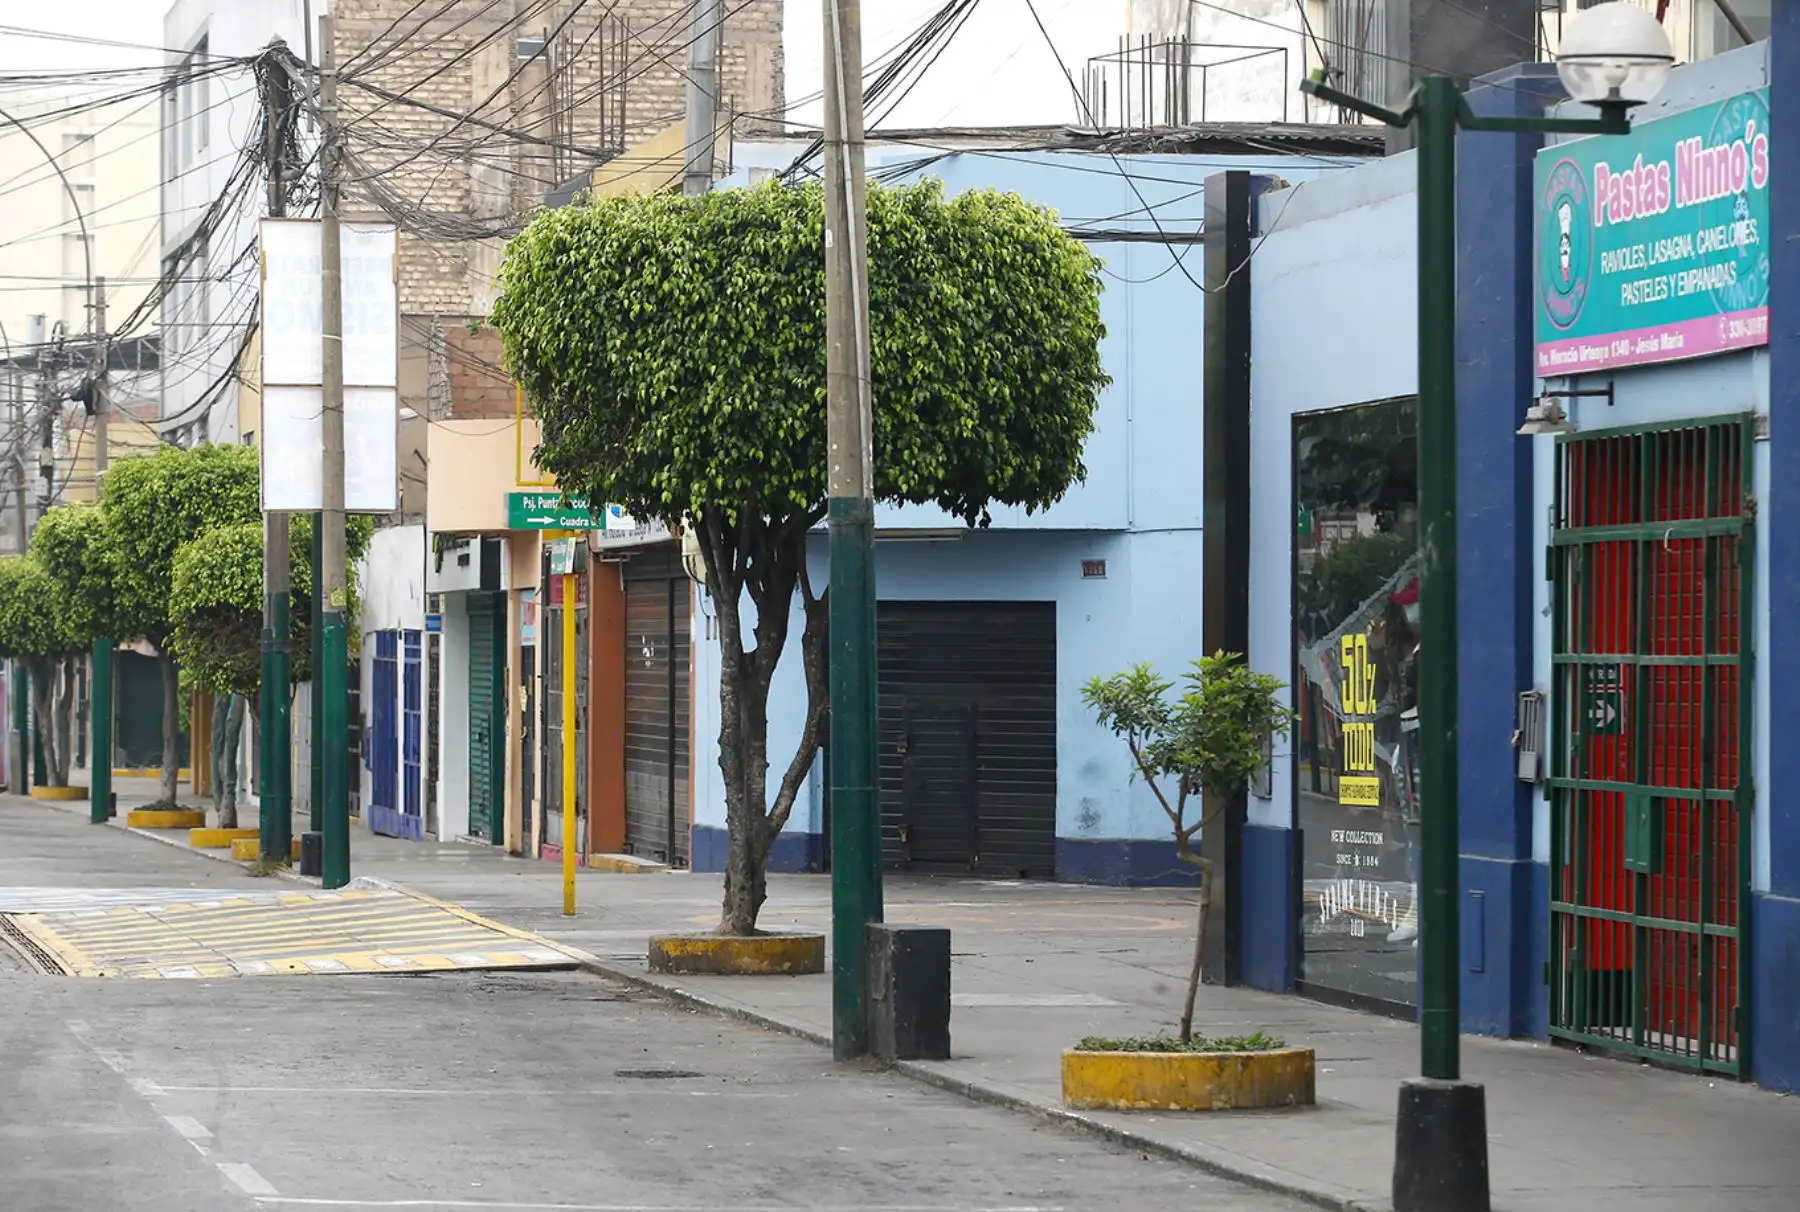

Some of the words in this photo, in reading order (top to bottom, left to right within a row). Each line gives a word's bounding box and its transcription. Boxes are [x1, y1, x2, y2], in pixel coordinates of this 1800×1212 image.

[1594, 153, 1671, 227] Pastas
[1649, 233, 1695, 260] LASAGNA,
[1696, 218, 1760, 255] CANELONES,
[1621, 274, 1668, 306] PASTELES
[1669, 273, 1677, 297] Y
[1678, 261, 1738, 296] EMPANADAS
[523, 496, 536, 511] Psj.
[560, 516, 589, 526] Cuadra
[1341, 634, 1376, 714] 50%
[1342, 723, 1375, 770] TODO
[1331, 830, 1345, 842] NEW
[1346, 831, 1383, 844] COLLECTION
[1336, 854, 1351, 864] SINCE
[1320, 879, 1354, 924] SPRING
